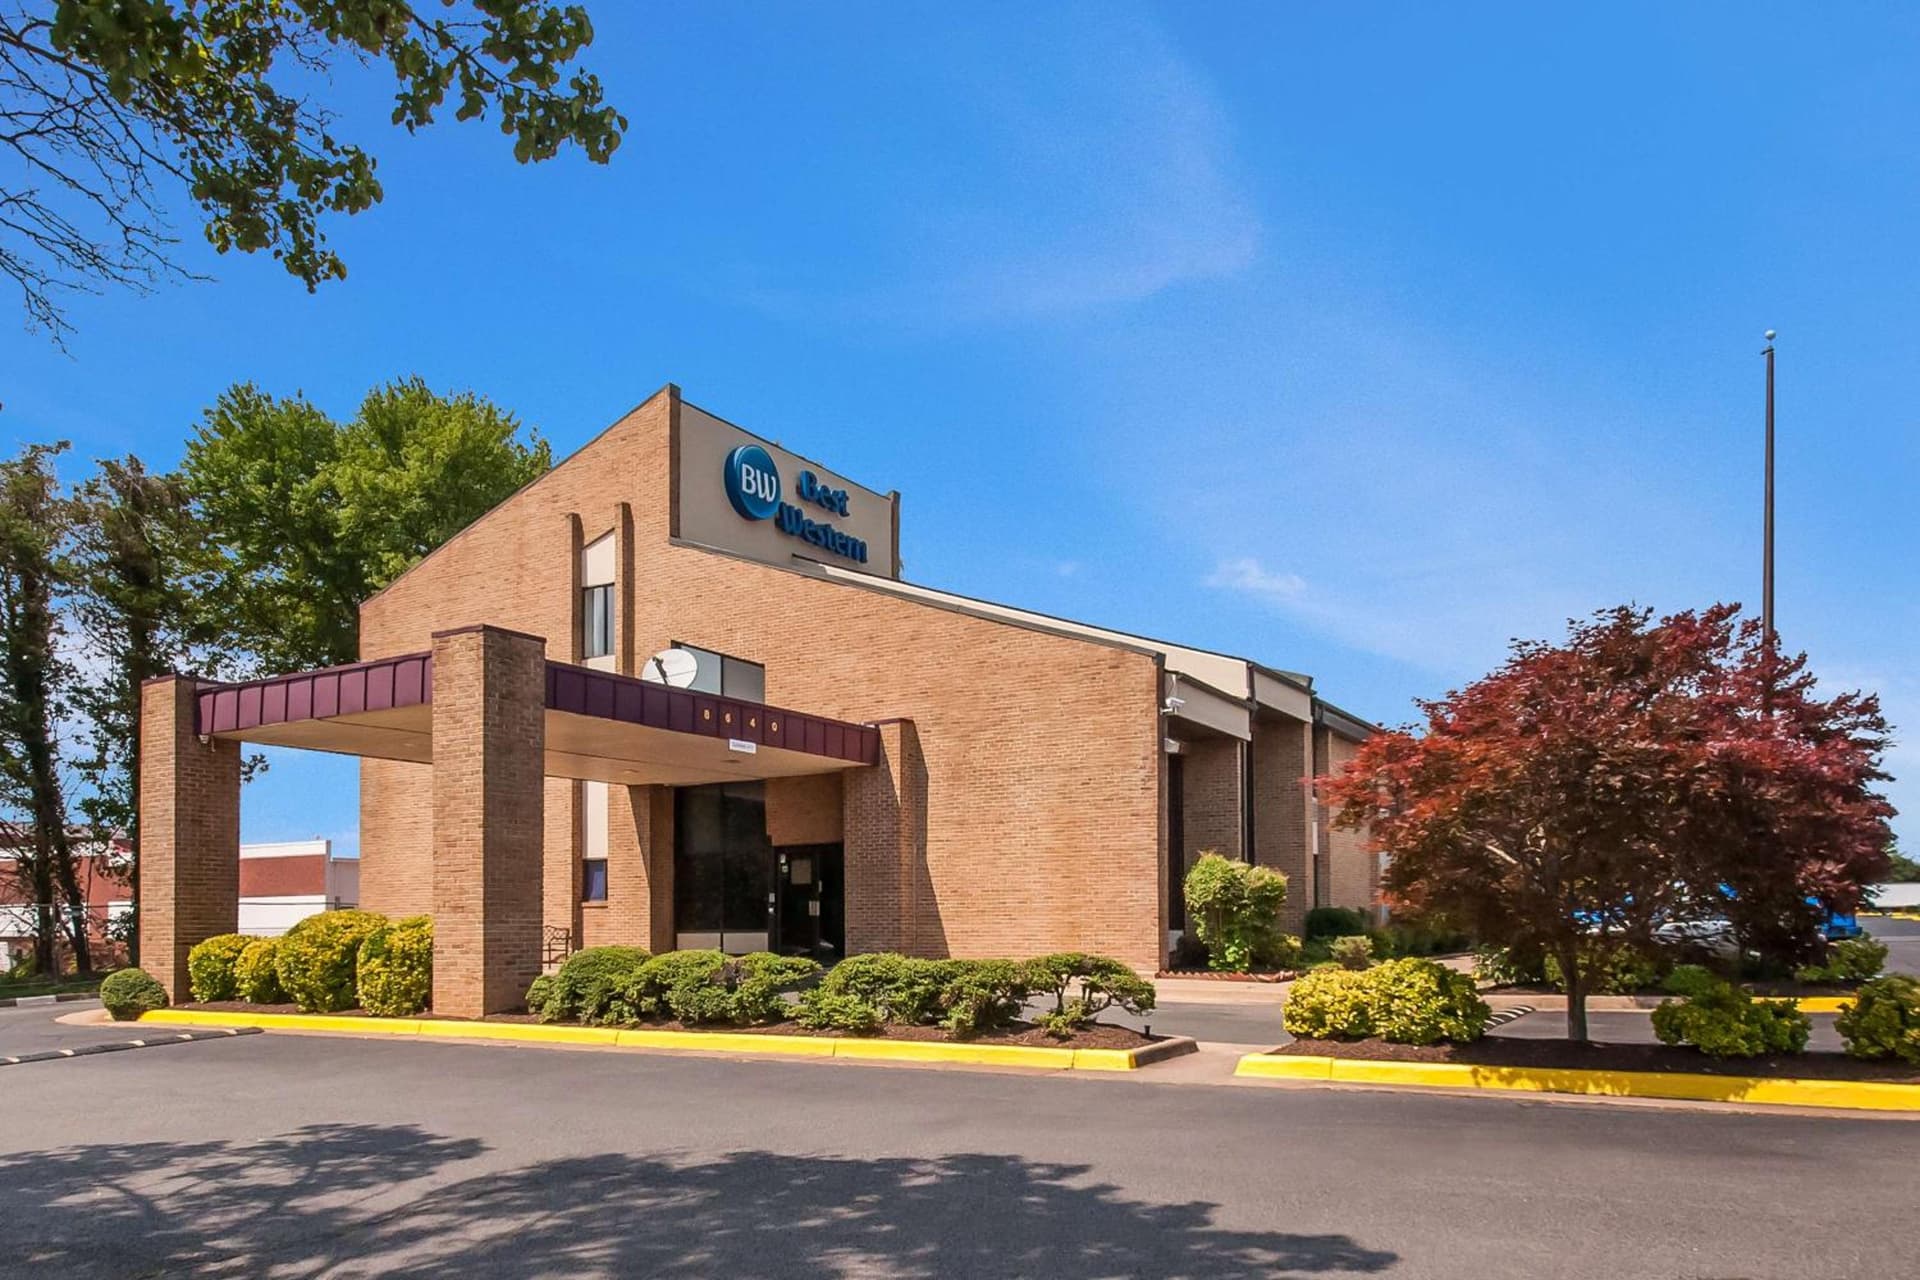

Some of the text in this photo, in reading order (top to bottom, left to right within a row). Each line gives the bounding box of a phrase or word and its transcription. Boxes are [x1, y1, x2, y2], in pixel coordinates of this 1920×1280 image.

[741, 463, 777, 502] BW
[796, 470, 850, 517] Best
[775, 501, 868, 563] Western
